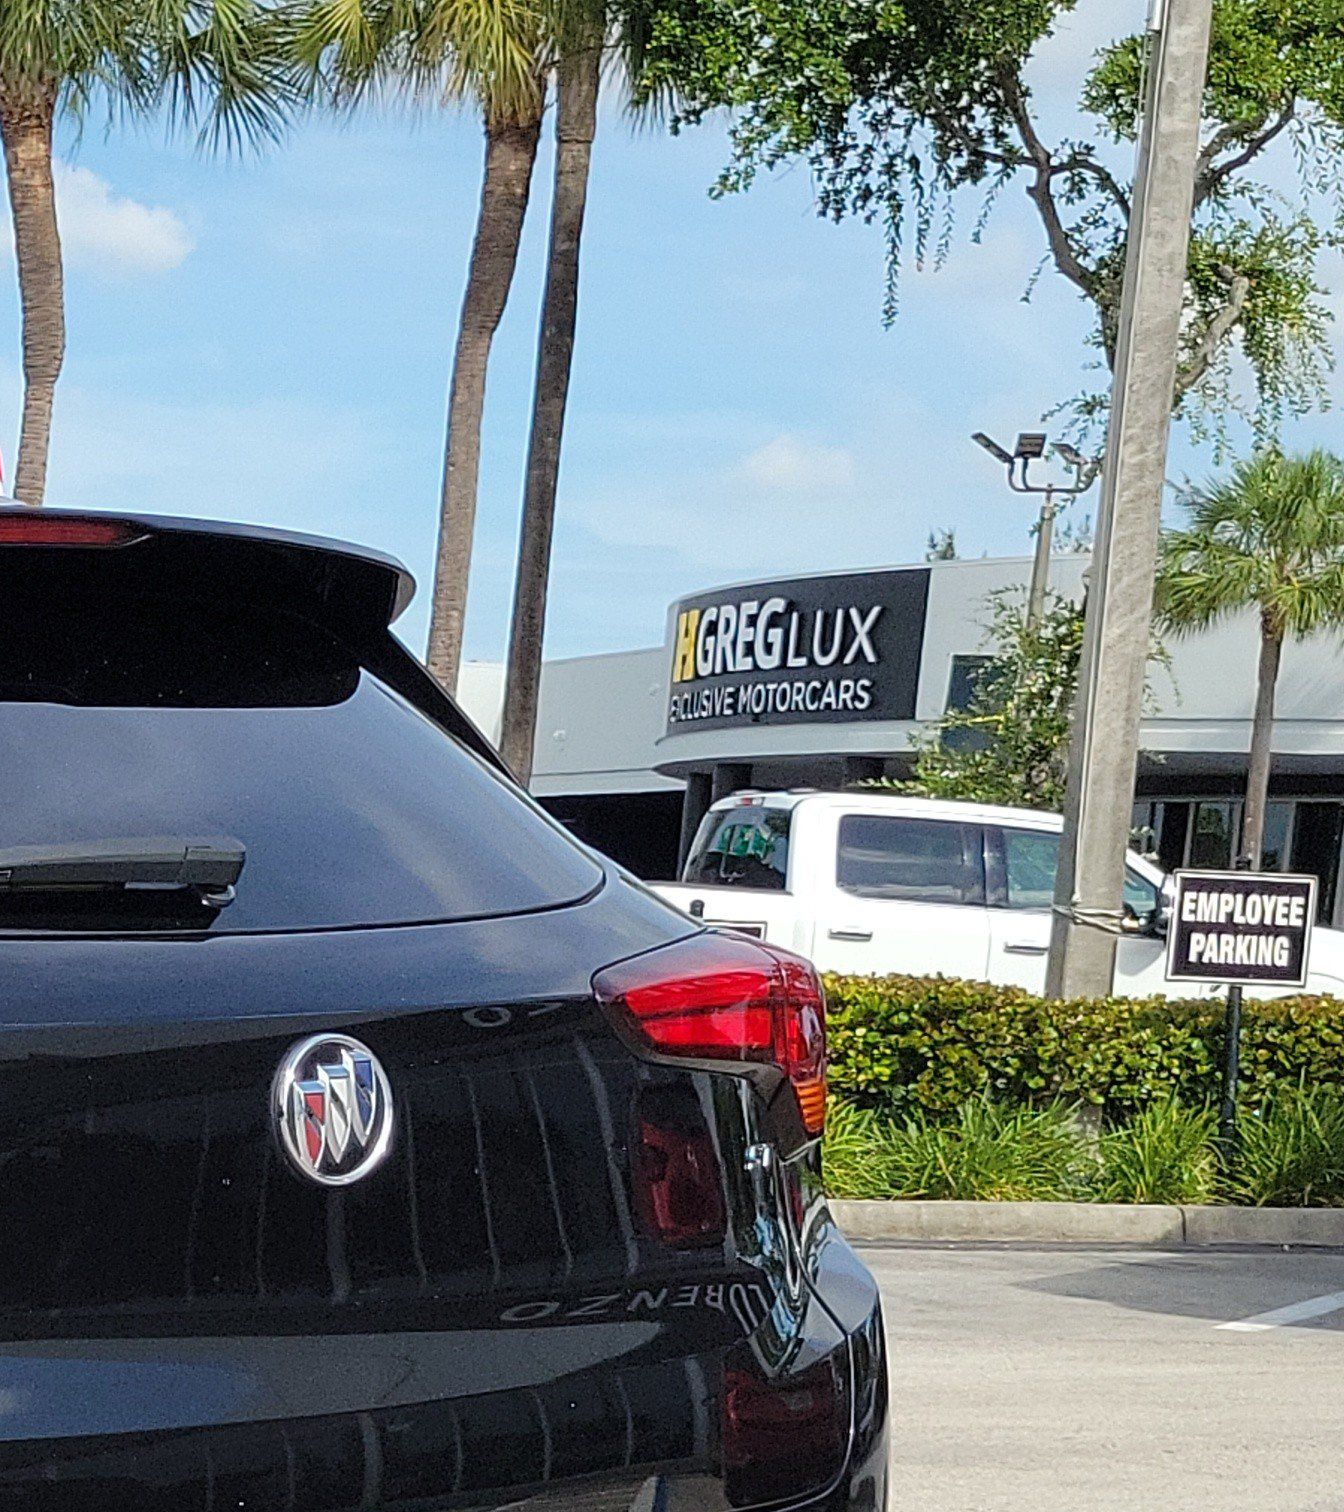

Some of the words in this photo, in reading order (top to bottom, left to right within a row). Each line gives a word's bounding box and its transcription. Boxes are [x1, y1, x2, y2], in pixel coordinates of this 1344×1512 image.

[737, 679, 873, 715] MOTORCARS
[1181, 891, 1305, 927] EMPLOYEE
[1188, 932, 1290, 967] PARKING
